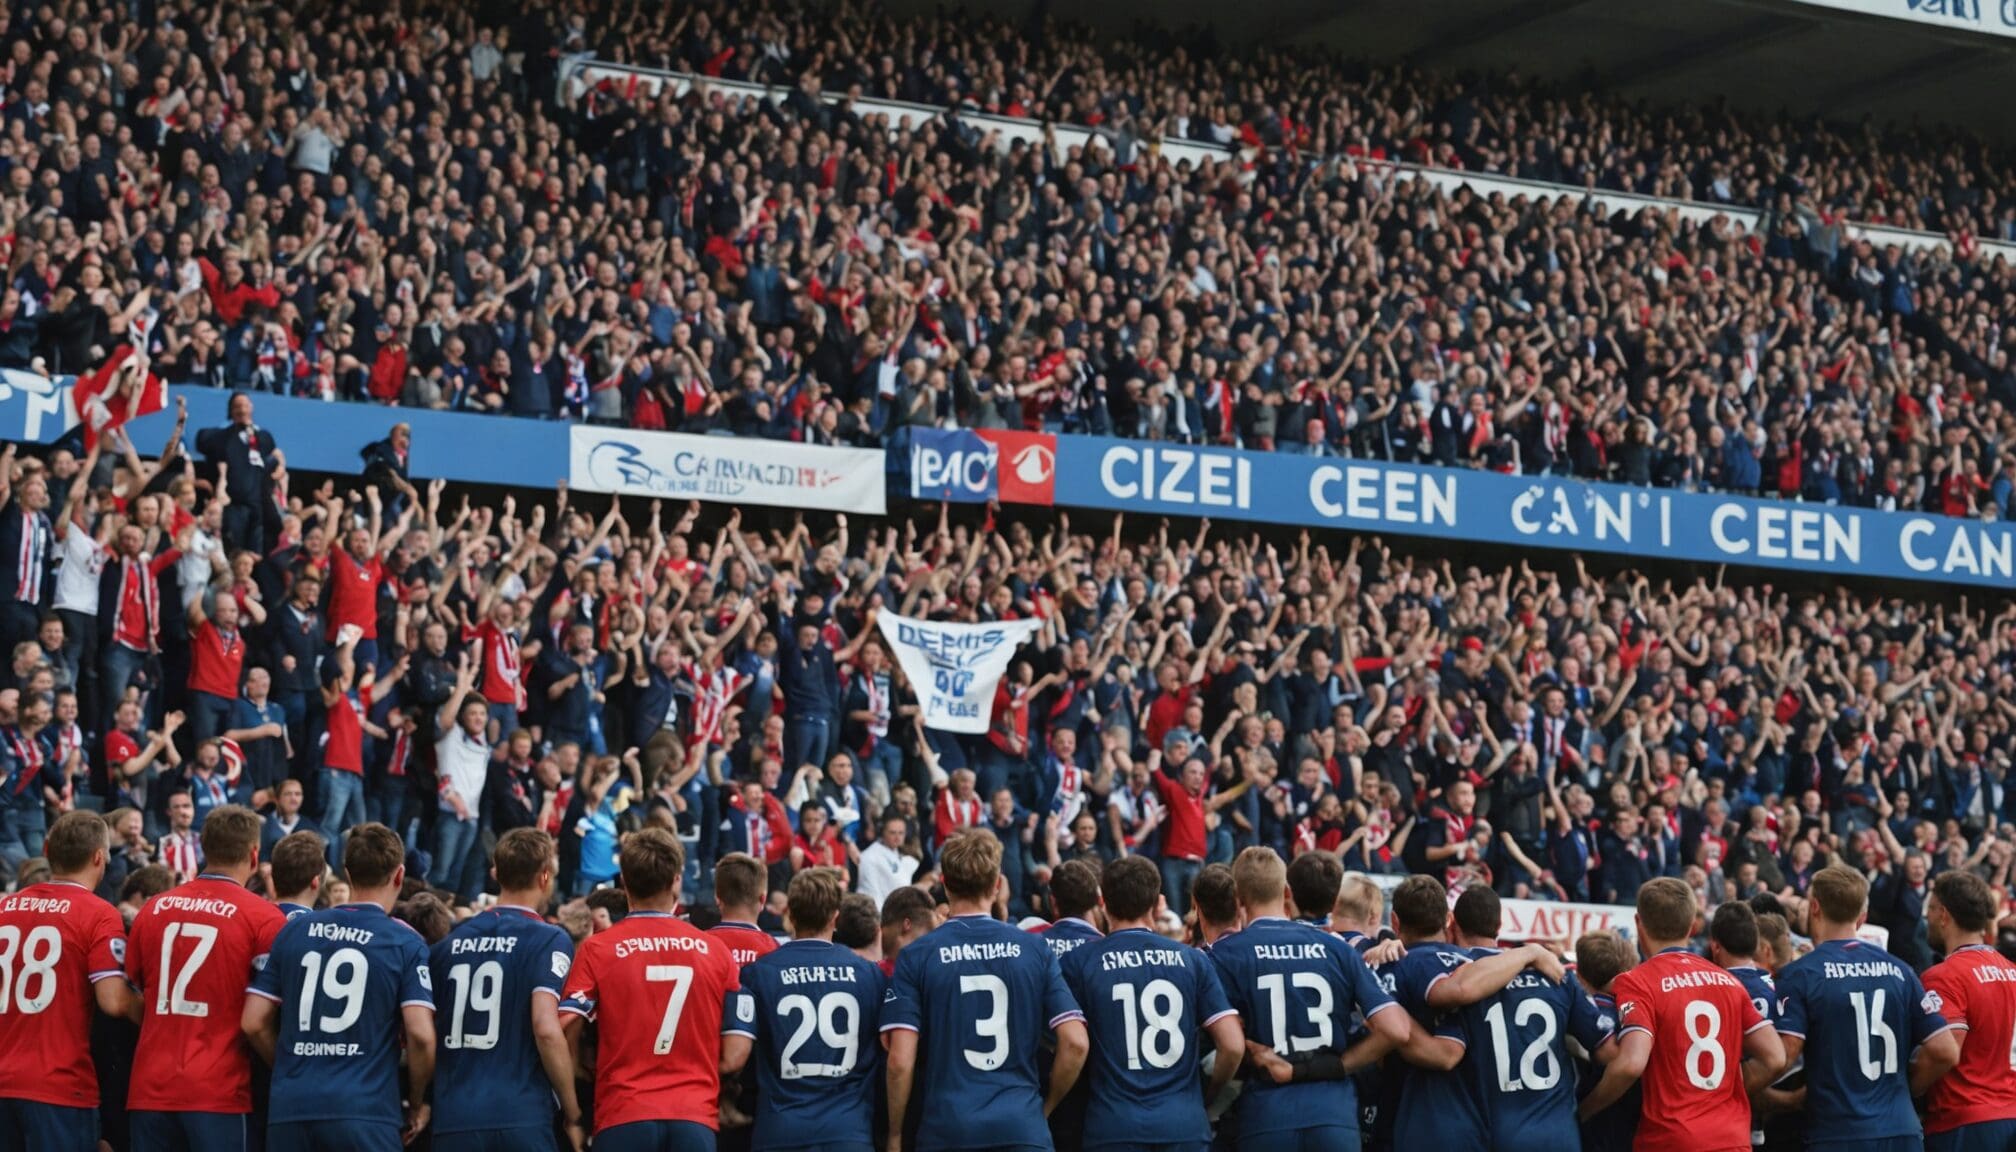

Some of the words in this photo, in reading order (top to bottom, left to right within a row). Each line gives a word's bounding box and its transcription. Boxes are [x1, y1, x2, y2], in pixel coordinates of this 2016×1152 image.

[1101, 446, 1251, 509] CIZEI
[1309, 465, 1457, 527] CEEN
[1710, 503, 1861, 564] CEEN
[298, 948, 369, 1034] 19
[444, 960, 504, 1050] 19
[645, 965, 694, 1055] 7
[776, 991, 860, 1079] 29
[959, 974, 1010, 1072] 3
[1112, 979, 1186, 1070] 18
[1257, 972, 1334, 1056] 13
[1684, 999, 1726, 1091] 8
